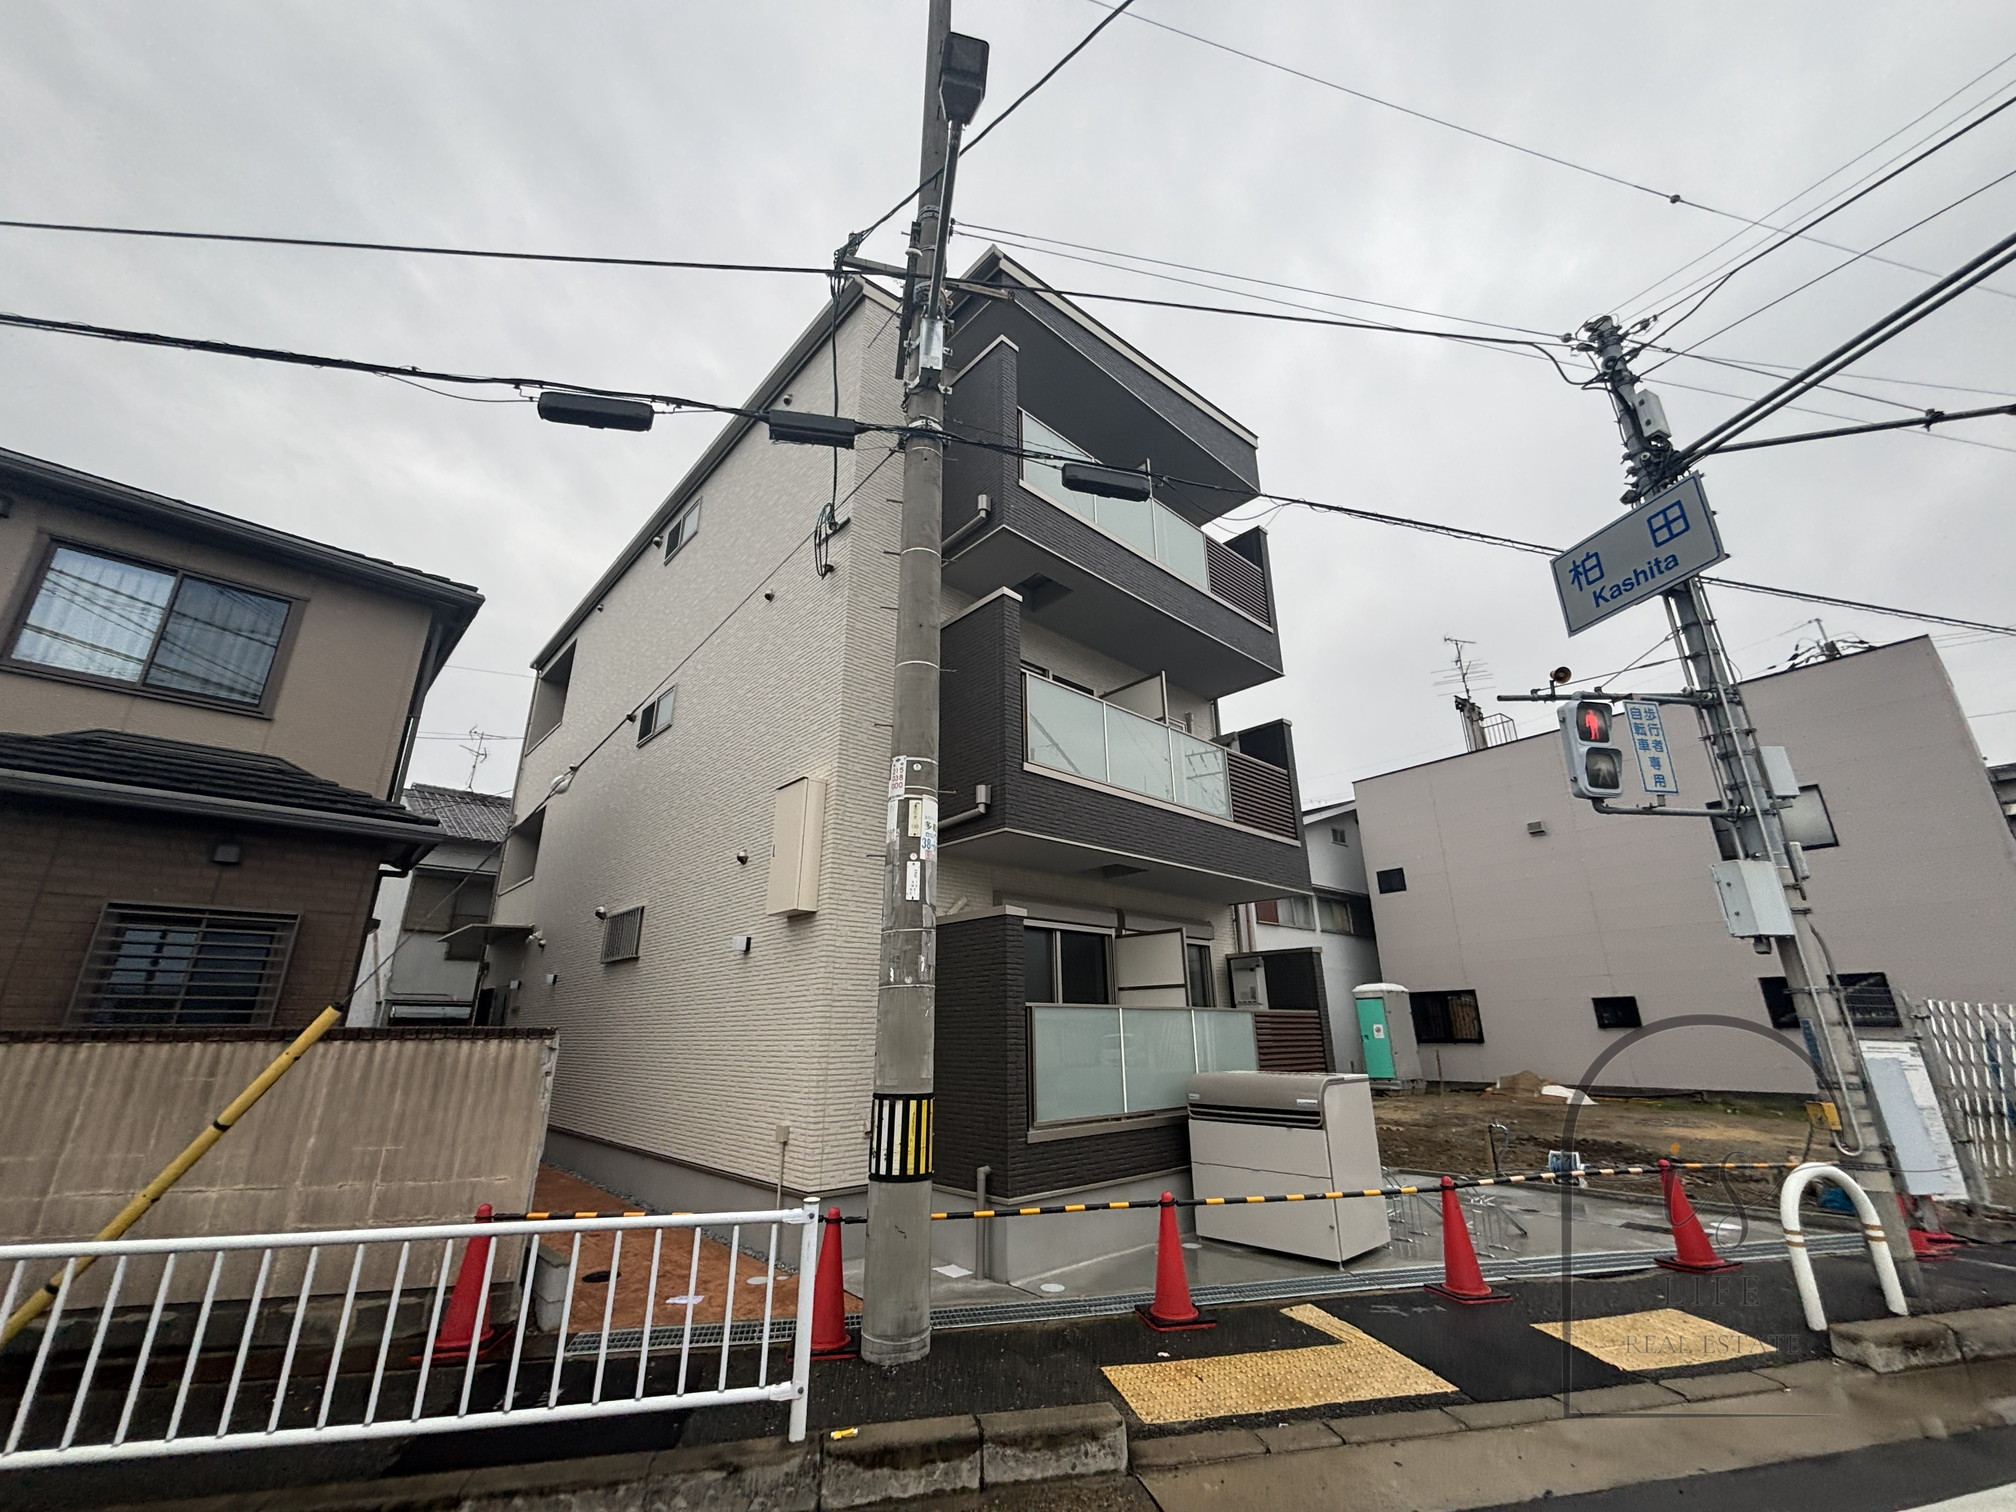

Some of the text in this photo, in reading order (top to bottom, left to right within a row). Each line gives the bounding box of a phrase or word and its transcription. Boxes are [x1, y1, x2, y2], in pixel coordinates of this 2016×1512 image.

[1568, 499, 1690, 592] 柏田
[1592, 553, 1680, 608] Kashita
[1629, 707, 1651, 752] 自転車
[1643, 707, 1664, 753] 歩行者
[1648, 756, 1667, 788] 専用
